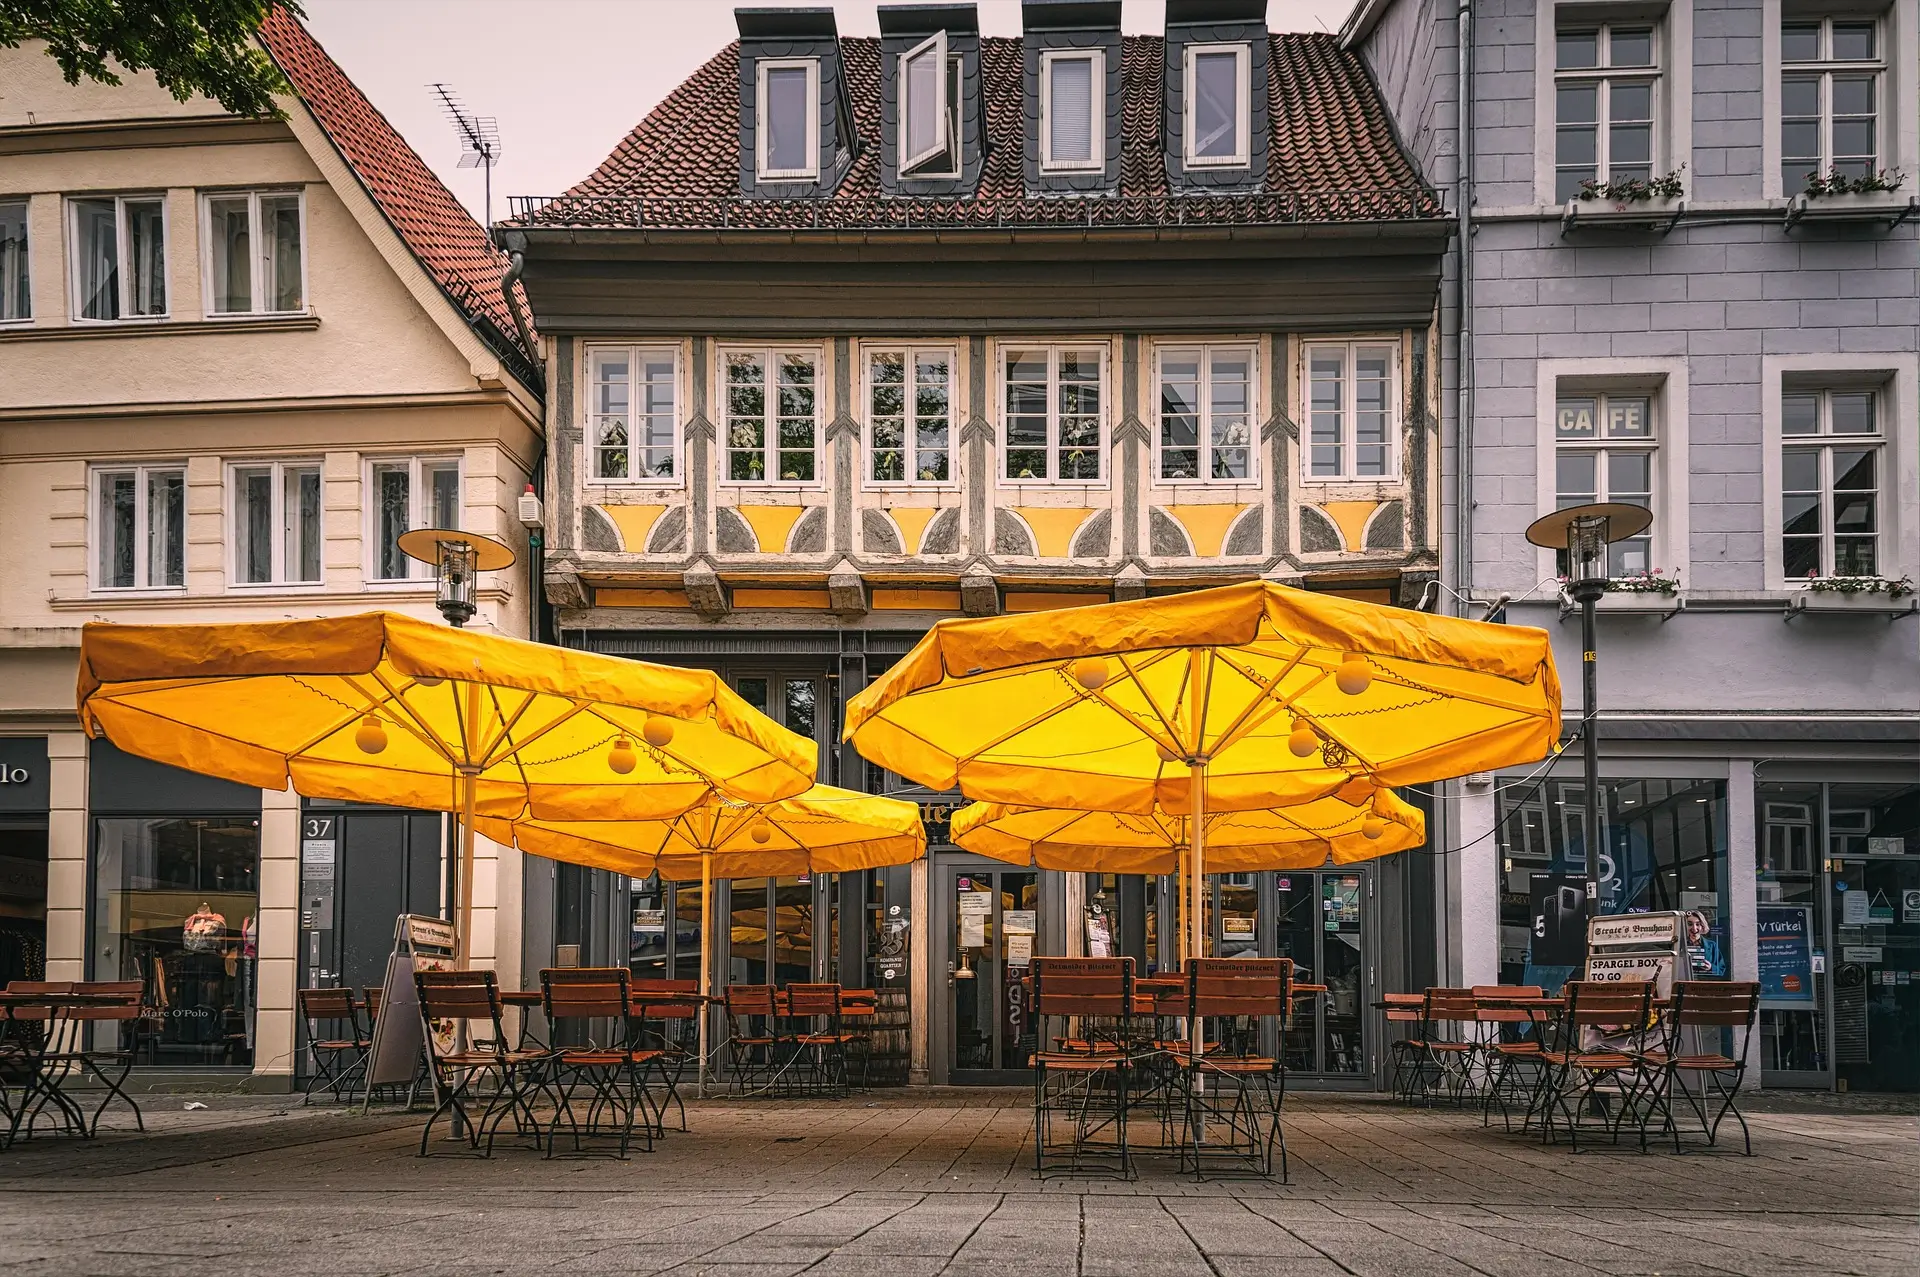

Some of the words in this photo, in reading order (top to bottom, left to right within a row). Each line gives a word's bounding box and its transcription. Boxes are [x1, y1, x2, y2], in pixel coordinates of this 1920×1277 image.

[1558, 403, 1640, 430] CAFÉ
[306, 819, 331, 837] 37
[1594, 925, 1629, 935] Strate's
[1632, 923, 1673, 935] Brauhaus
[1769, 921, 1802, 932] Türkei
[1592, 959, 1634, 969] SPARGEL
[1637, 958, 1659, 968] BOX
[1591, 972, 1604, 981] TO
[1607, 972, 1622, 981] GO
[140, 1009, 169, 1018] Marc
[172, 1009, 209, 1018] O'Polo
